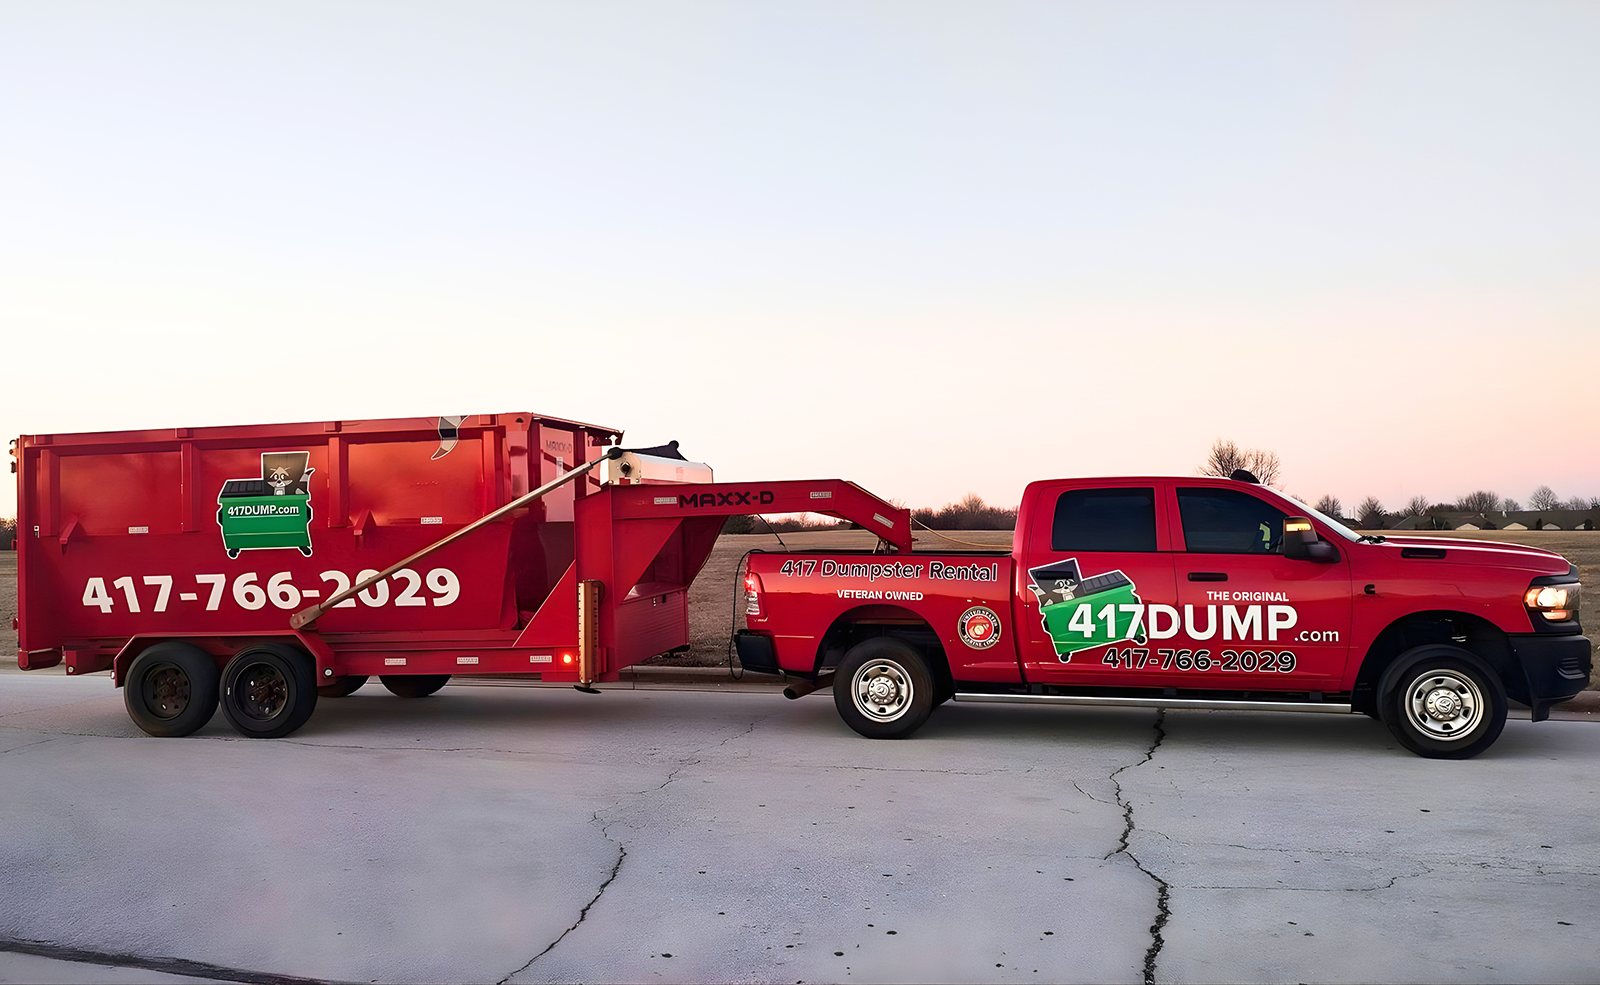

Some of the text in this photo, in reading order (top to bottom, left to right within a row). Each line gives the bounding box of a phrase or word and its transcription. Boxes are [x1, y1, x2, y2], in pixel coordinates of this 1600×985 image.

[678, 490, 775, 508] MAXX-D
[227, 504, 299, 516] 417DUMP.com
[780, 560, 998, 582] 417 Dumpster Rental
[81, 567, 461, 613] 417-766-2029
[836, 589, 924, 600] VETERAN OWNED
[1206, 591, 1290, 602] THE ORIGINAL
[1102, 647, 1297, 673] 417-766-2029
